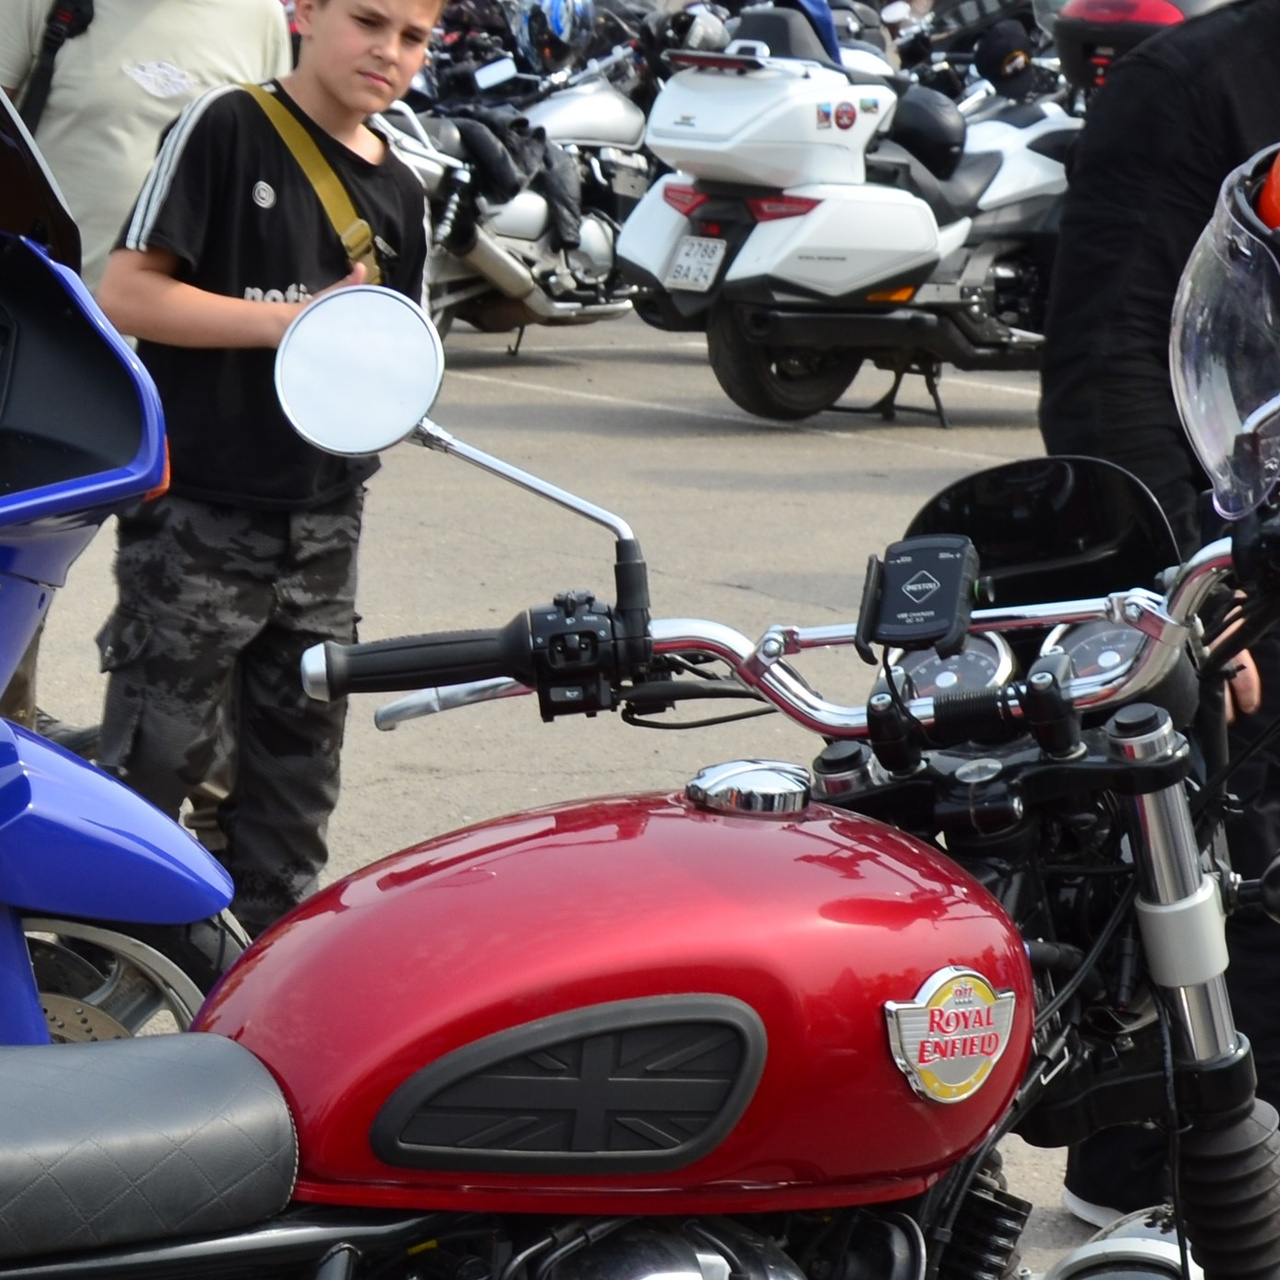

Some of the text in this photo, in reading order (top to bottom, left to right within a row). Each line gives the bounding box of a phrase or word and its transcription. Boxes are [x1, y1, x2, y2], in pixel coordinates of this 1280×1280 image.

[684, 242, 718, 260] 2788
[928, 1006, 995, 1035] ROYAL
[918, 1033, 999, 1064] ENFIELD
